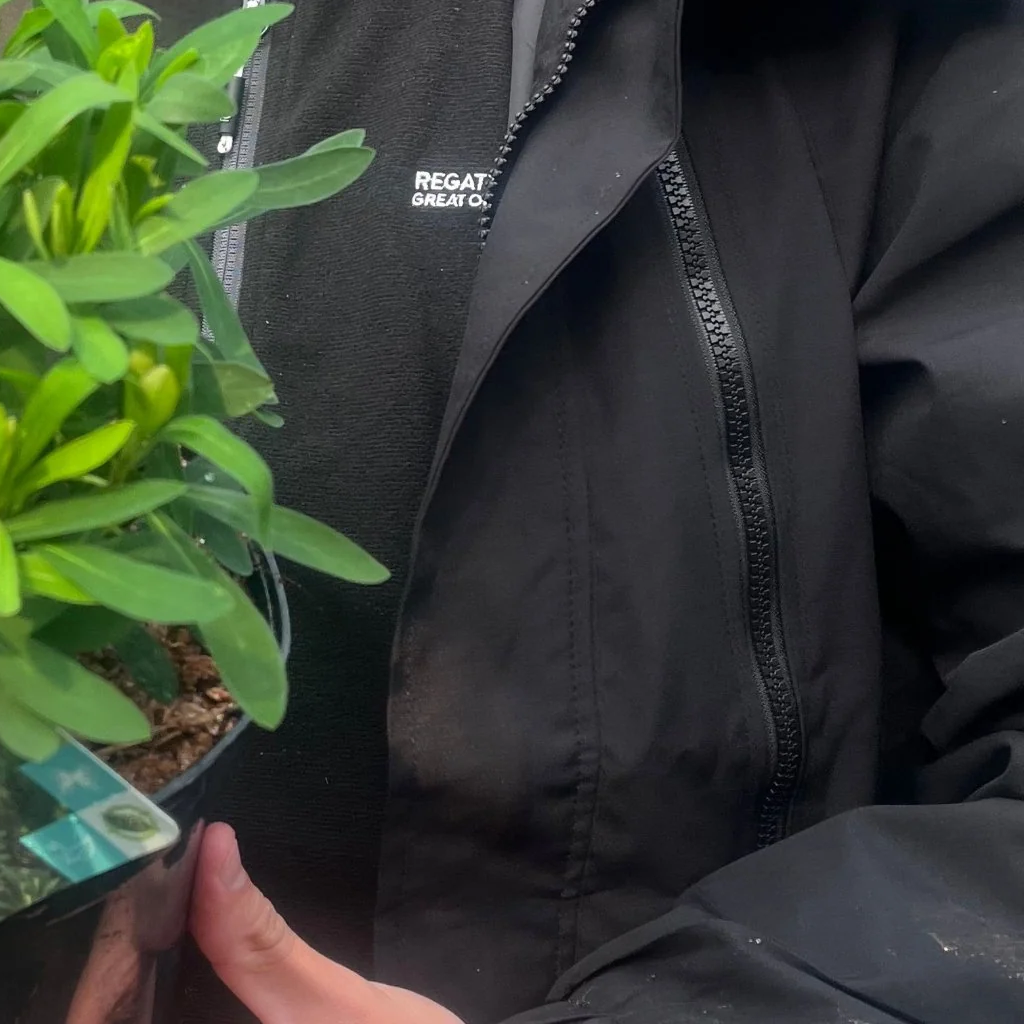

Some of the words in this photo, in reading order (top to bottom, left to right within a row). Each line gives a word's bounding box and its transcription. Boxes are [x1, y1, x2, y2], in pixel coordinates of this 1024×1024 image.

[415, 170, 488, 191] REGAT
[411, 192, 467, 208] GREAT
[468, 193, 488, 208] O
